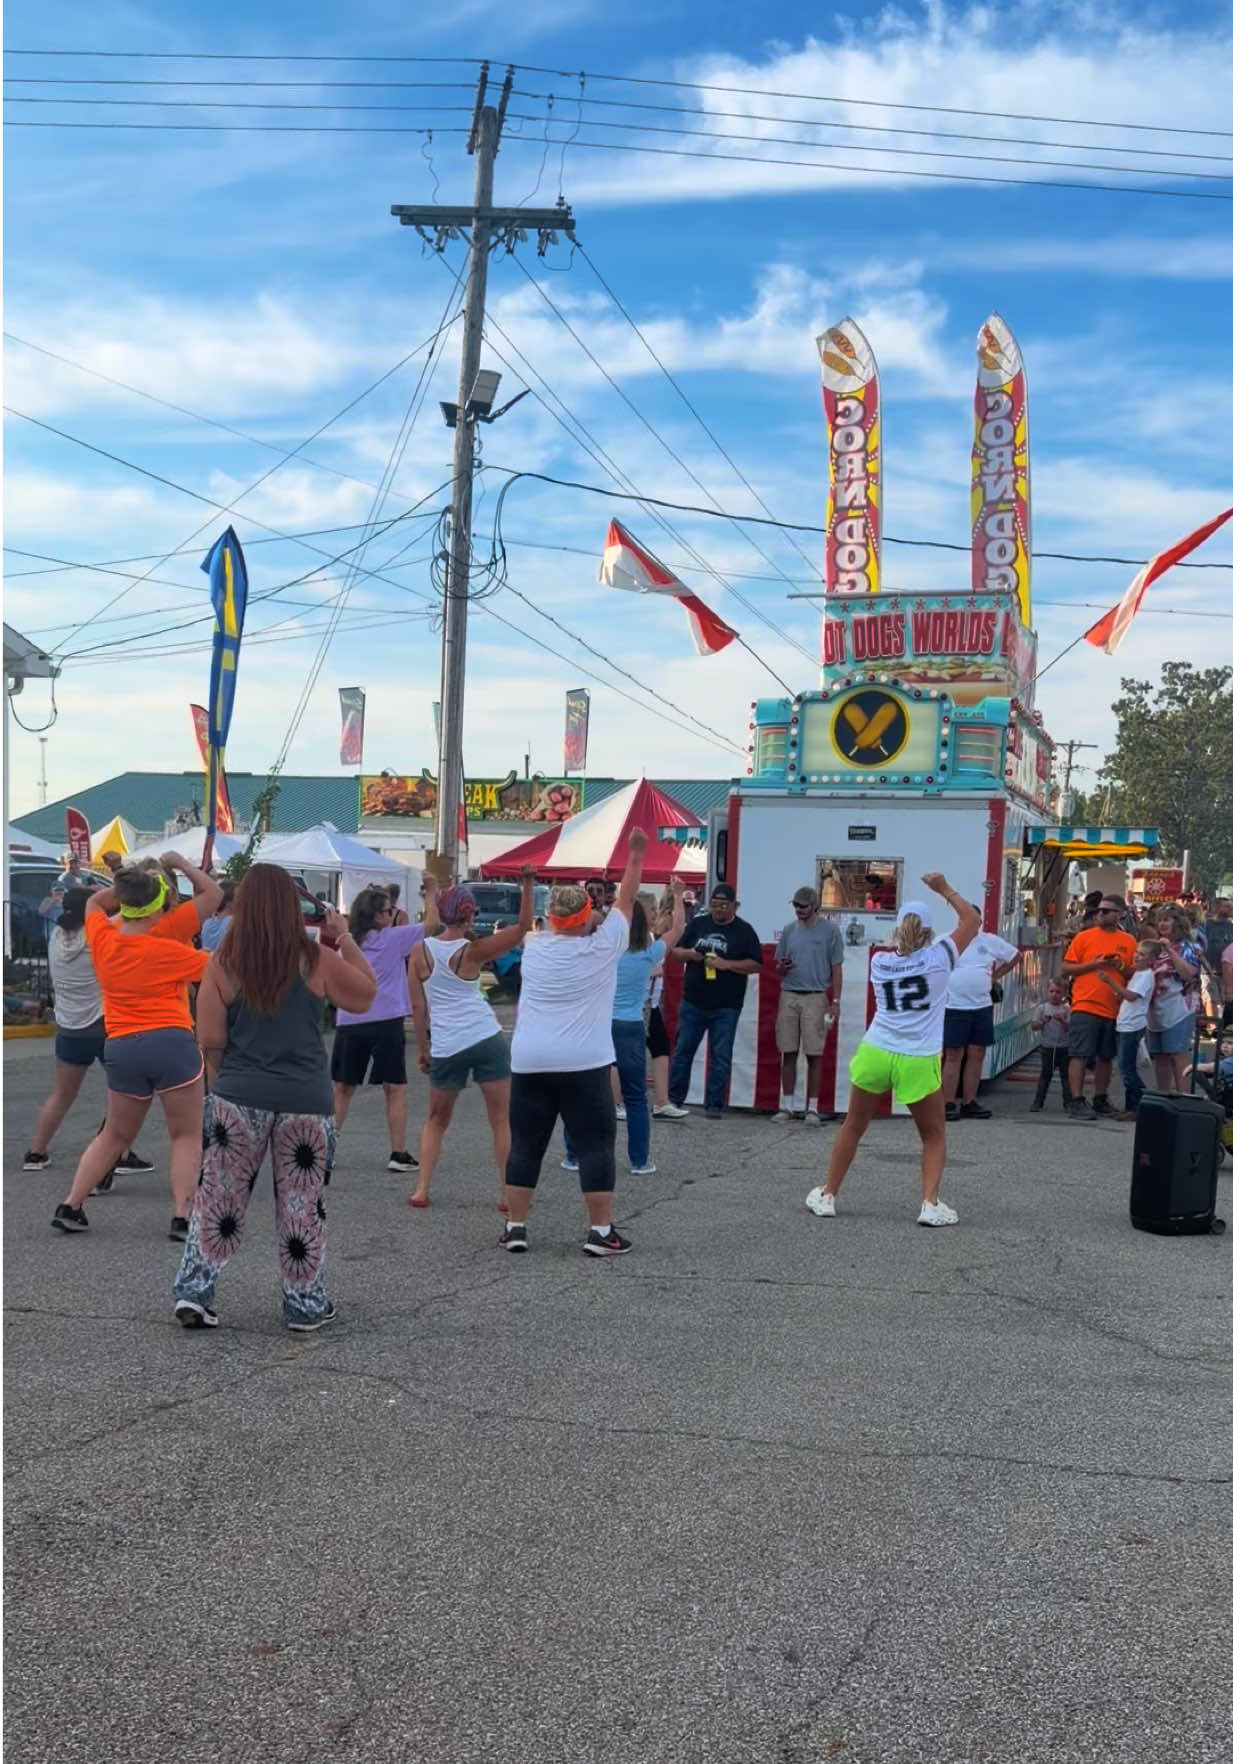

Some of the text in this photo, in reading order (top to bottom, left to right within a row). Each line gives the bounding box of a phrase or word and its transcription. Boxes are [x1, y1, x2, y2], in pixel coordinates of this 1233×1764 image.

[852, 613, 905, 660] DOGS
[911, 610, 997, 655] WORLDS
[882, 975, 930, 1011] 12
